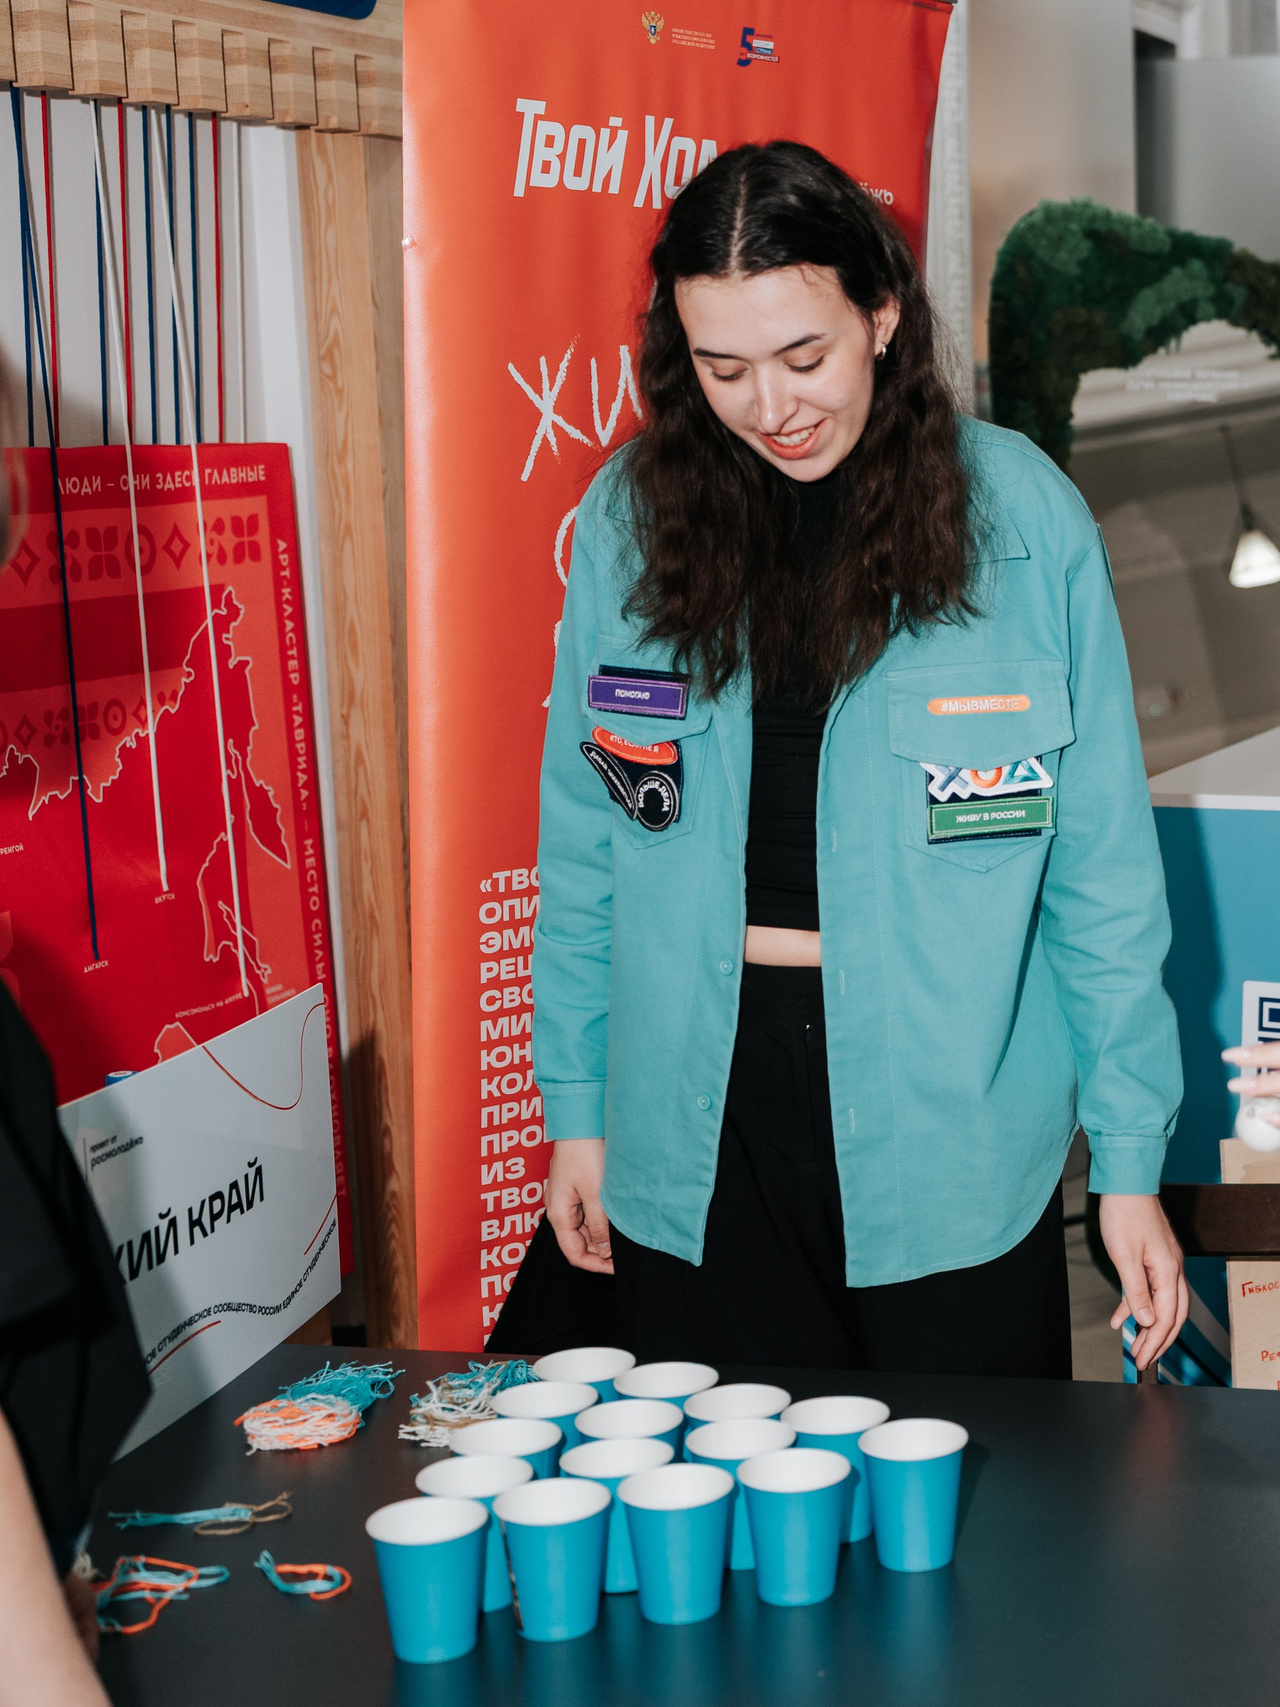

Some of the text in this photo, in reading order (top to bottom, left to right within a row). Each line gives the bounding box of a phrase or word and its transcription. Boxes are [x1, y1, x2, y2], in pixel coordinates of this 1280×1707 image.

[204, 465, 266, 485] ГЛАВНЫЕ
[277, 538, 300, 685] АРТ-КЛАСТЕР
[941, 698, 1020, 712] #МЫВМЕСТЕ
[955, 809, 1026, 823] ЖИВУ В РОССИИ
[303, 838, 320, 912] МЕСТО
[311, 919, 326, 980] СИЛЫ
[479, 925, 535, 954] ЭМ
[480, 1123, 555, 1157] ПРО
[480, 1156, 526, 1186] ИЗ
[187, 1156, 265, 1247] КРАЙ
[480, 1178, 549, 1213] ТВО
[480, 1240, 532, 1270] КО
[212, 1302, 257, 1314] СООБЩЕСТВО
[257, 1303, 282, 1316] РОССИИ
[282, 1278, 303, 1310] ЕДИНОЕ
